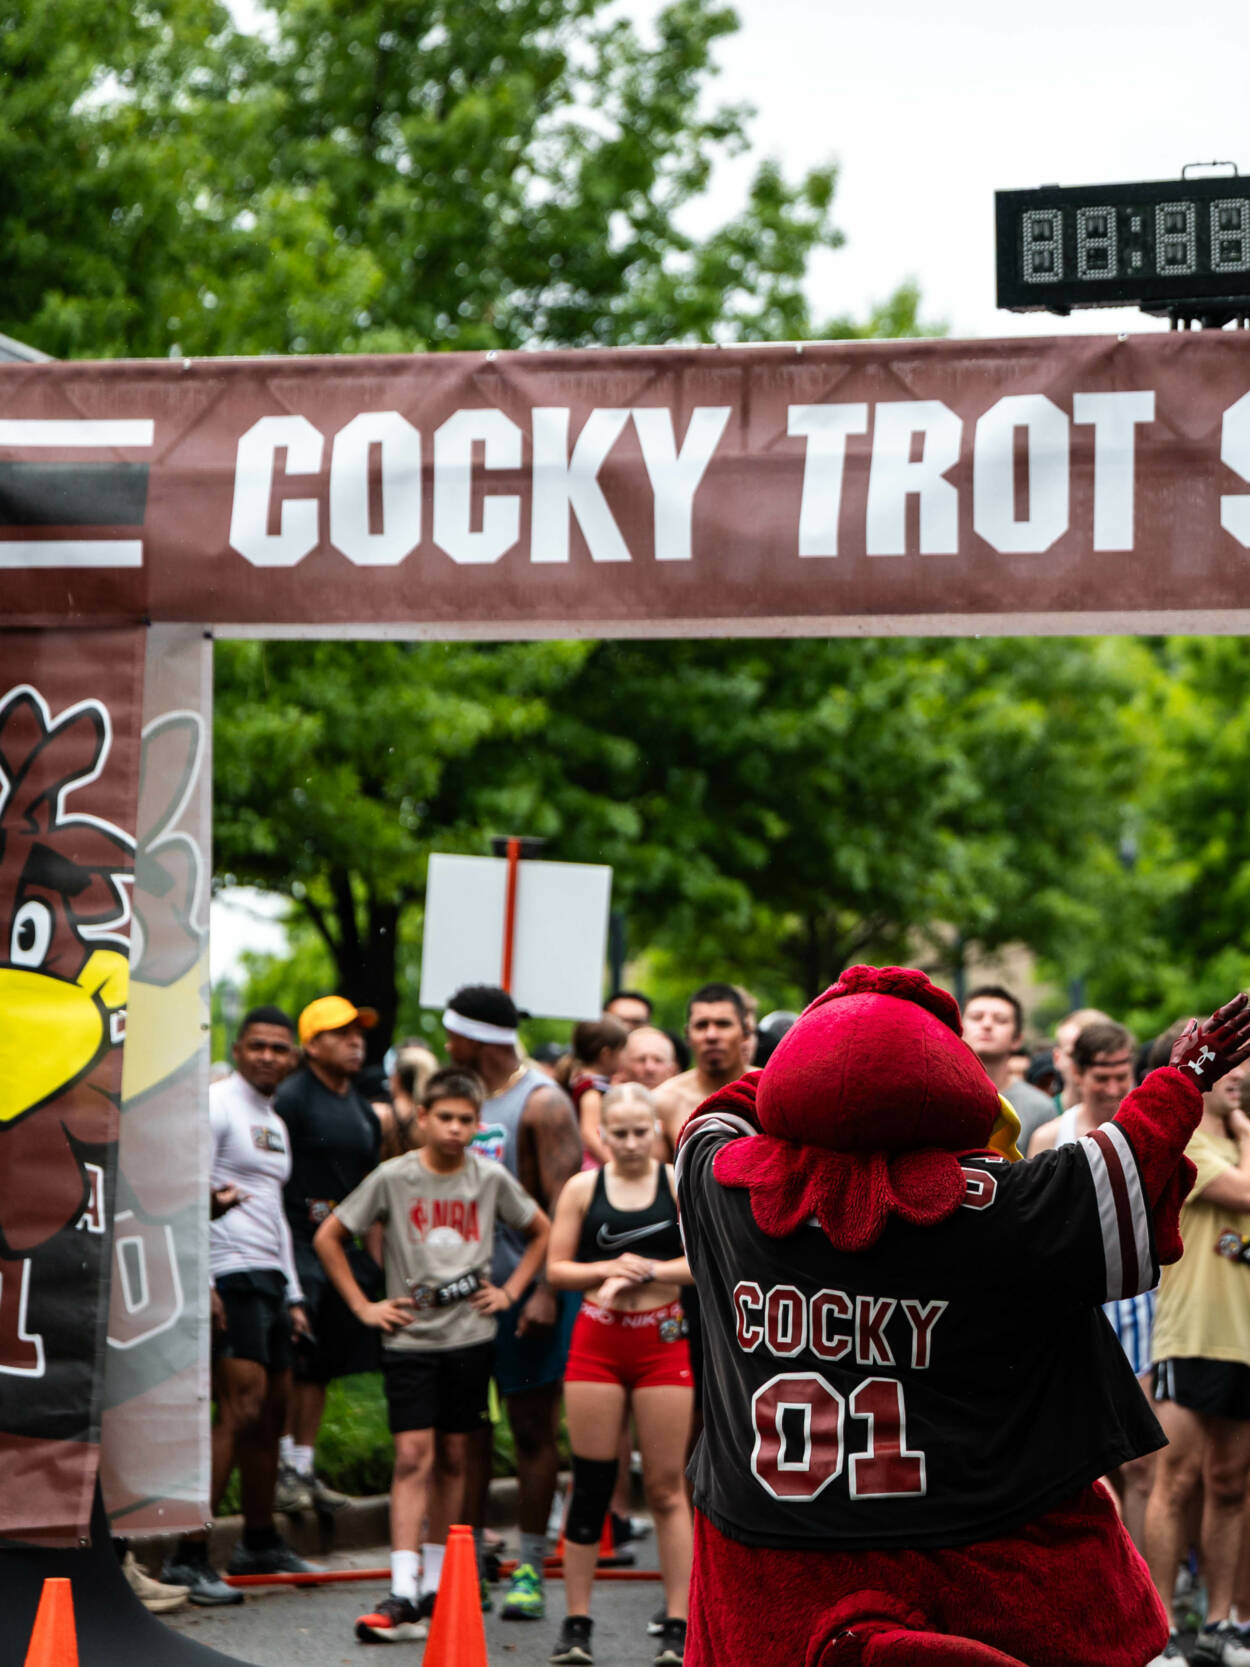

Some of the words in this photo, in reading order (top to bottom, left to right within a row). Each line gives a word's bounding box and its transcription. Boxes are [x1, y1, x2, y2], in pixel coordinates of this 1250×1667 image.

[229, 405, 732, 568] COCKY
[786, 389, 1156, 559] TROT
[433, 1199, 480, 1243] NBA
[733, 1280, 949, 1369] COCKY
[750, 1371, 927, 1503] 01
